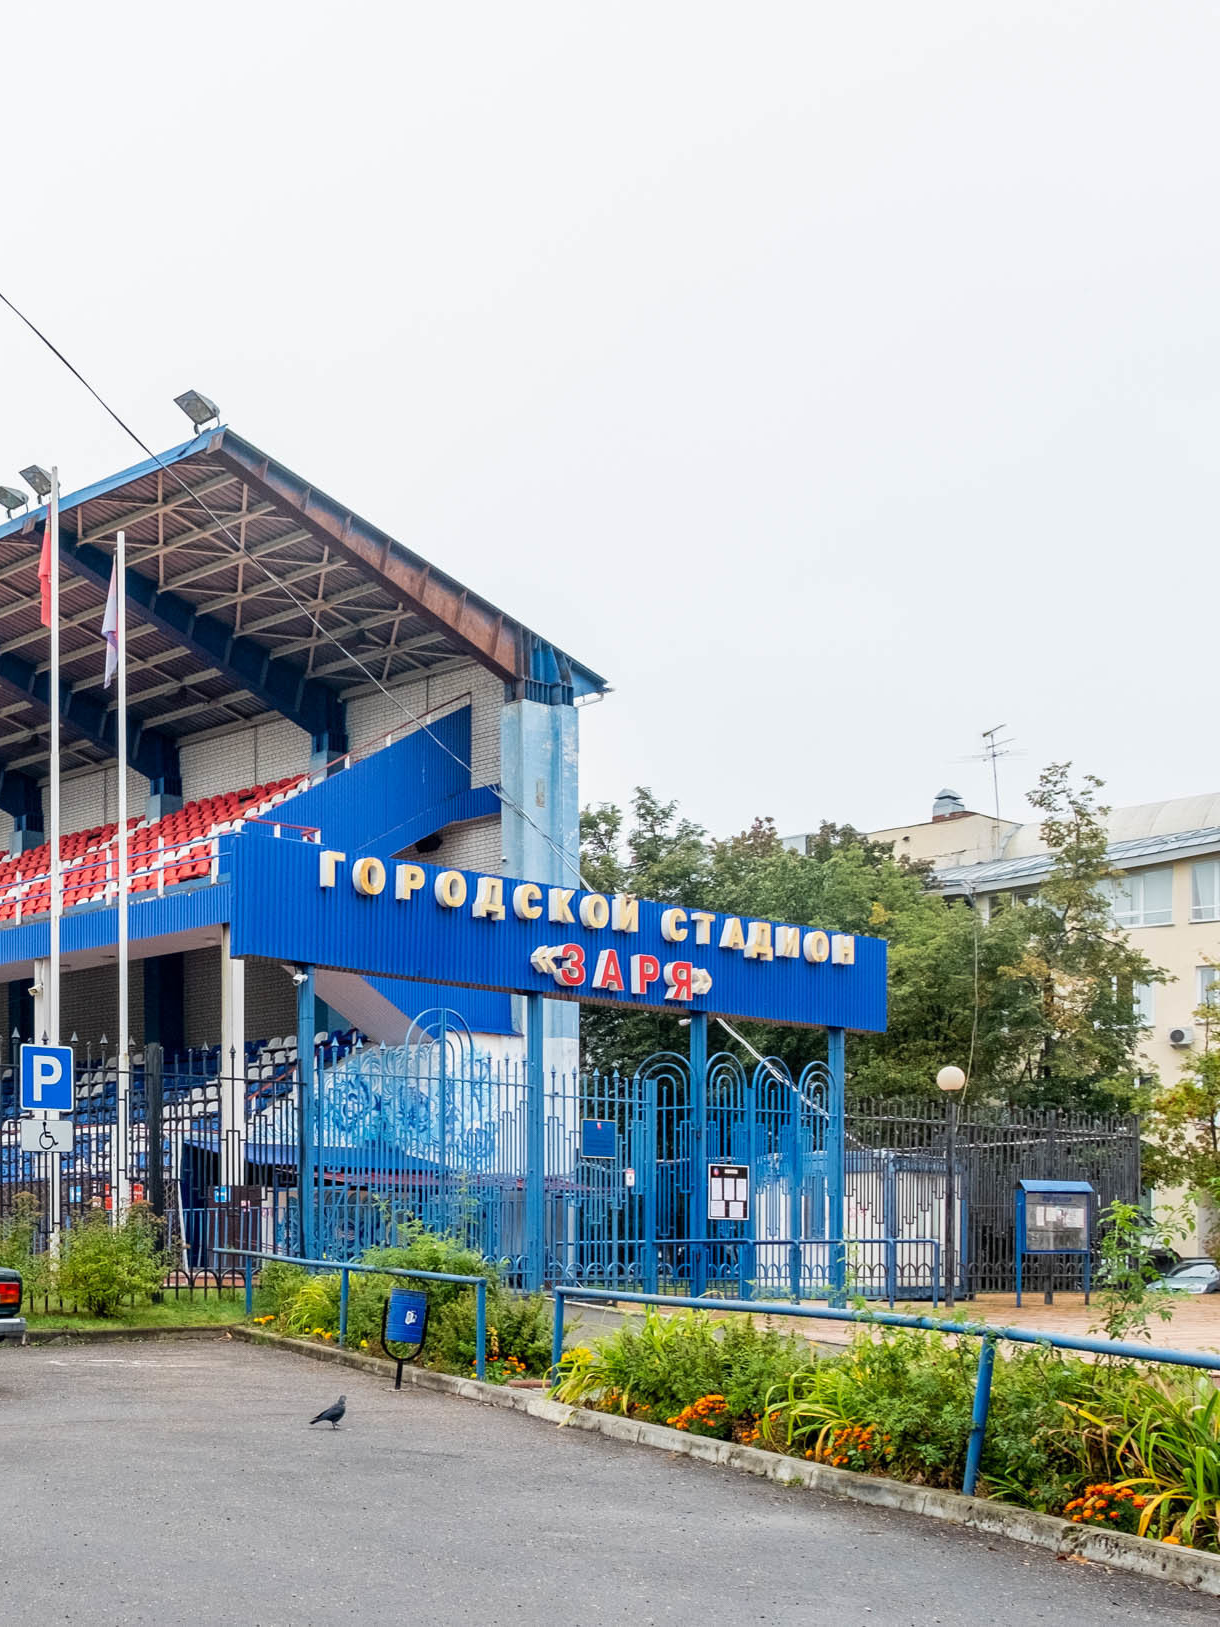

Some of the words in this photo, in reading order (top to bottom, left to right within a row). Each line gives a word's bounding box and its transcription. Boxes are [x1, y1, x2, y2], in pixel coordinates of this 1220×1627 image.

[319, 849, 639, 933] ГОРОДСКОЙ
[661, 907, 856, 965] СТАДИОН
[530, 943, 713, 1001] «ЗАРЯ»
[32, 1054, 63, 1102] P
